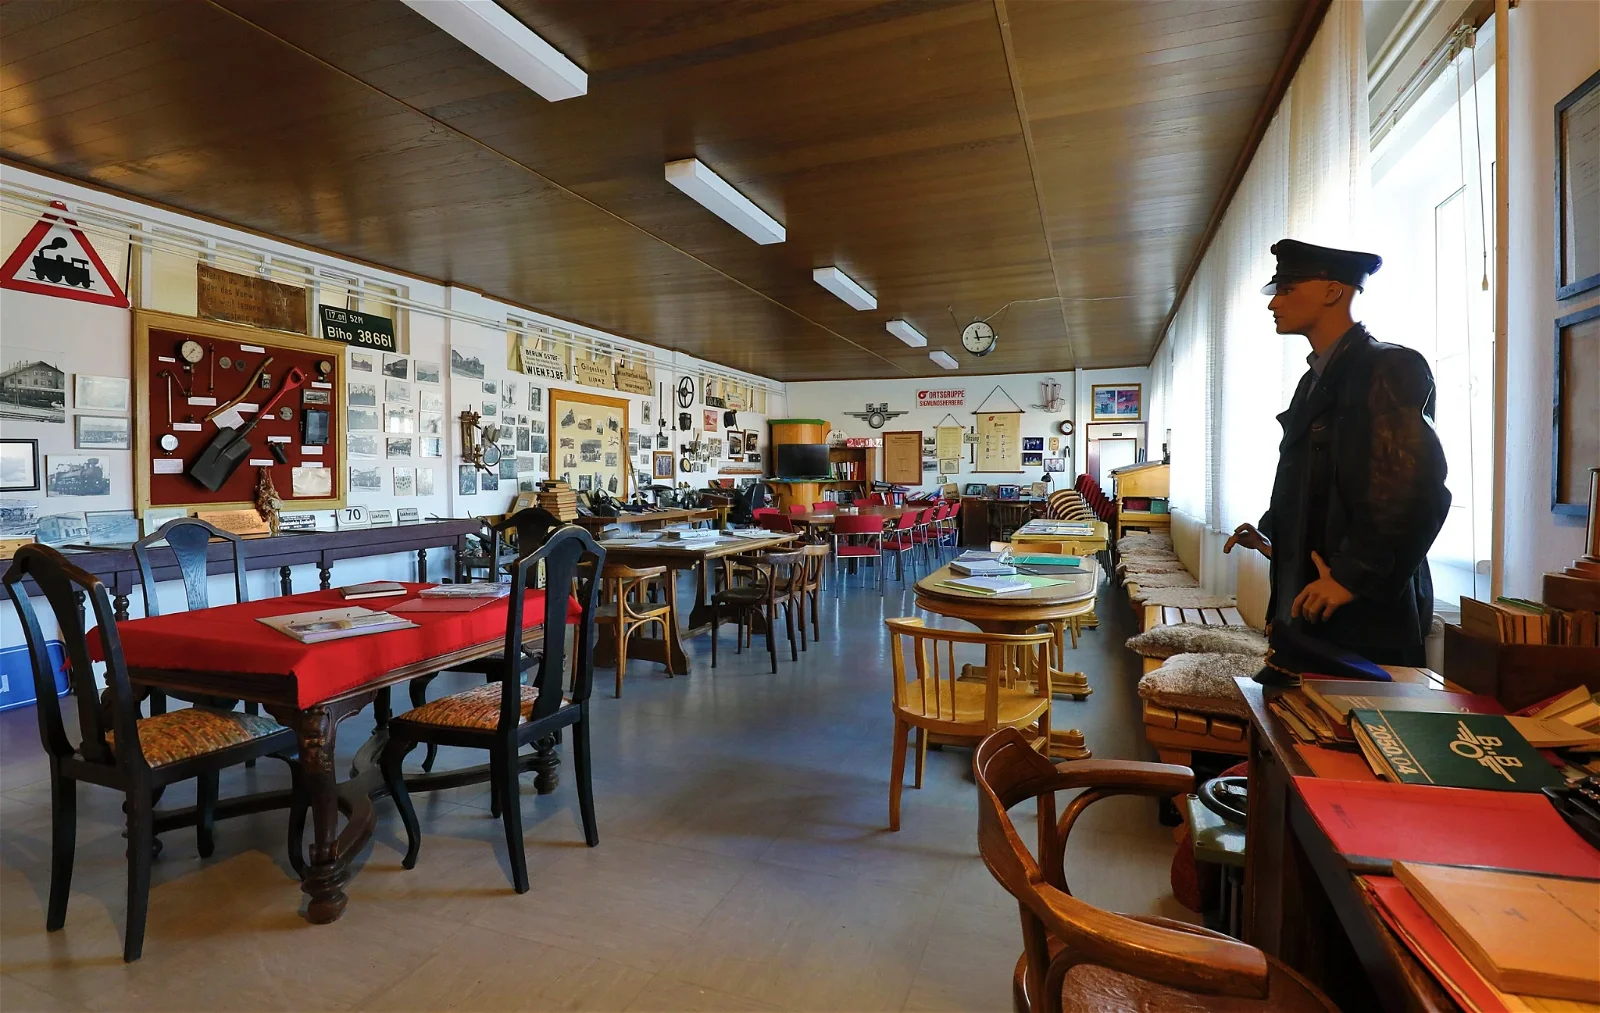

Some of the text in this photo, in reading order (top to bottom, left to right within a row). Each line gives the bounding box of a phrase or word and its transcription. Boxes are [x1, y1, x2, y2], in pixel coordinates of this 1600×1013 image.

[327, 326, 392, 348] Biho 38661
[929, 390, 965, 399] ORTSGRUPPE
[345, 508, 361, 521] 70
[1366, 723, 1419, 775] 2050.04
